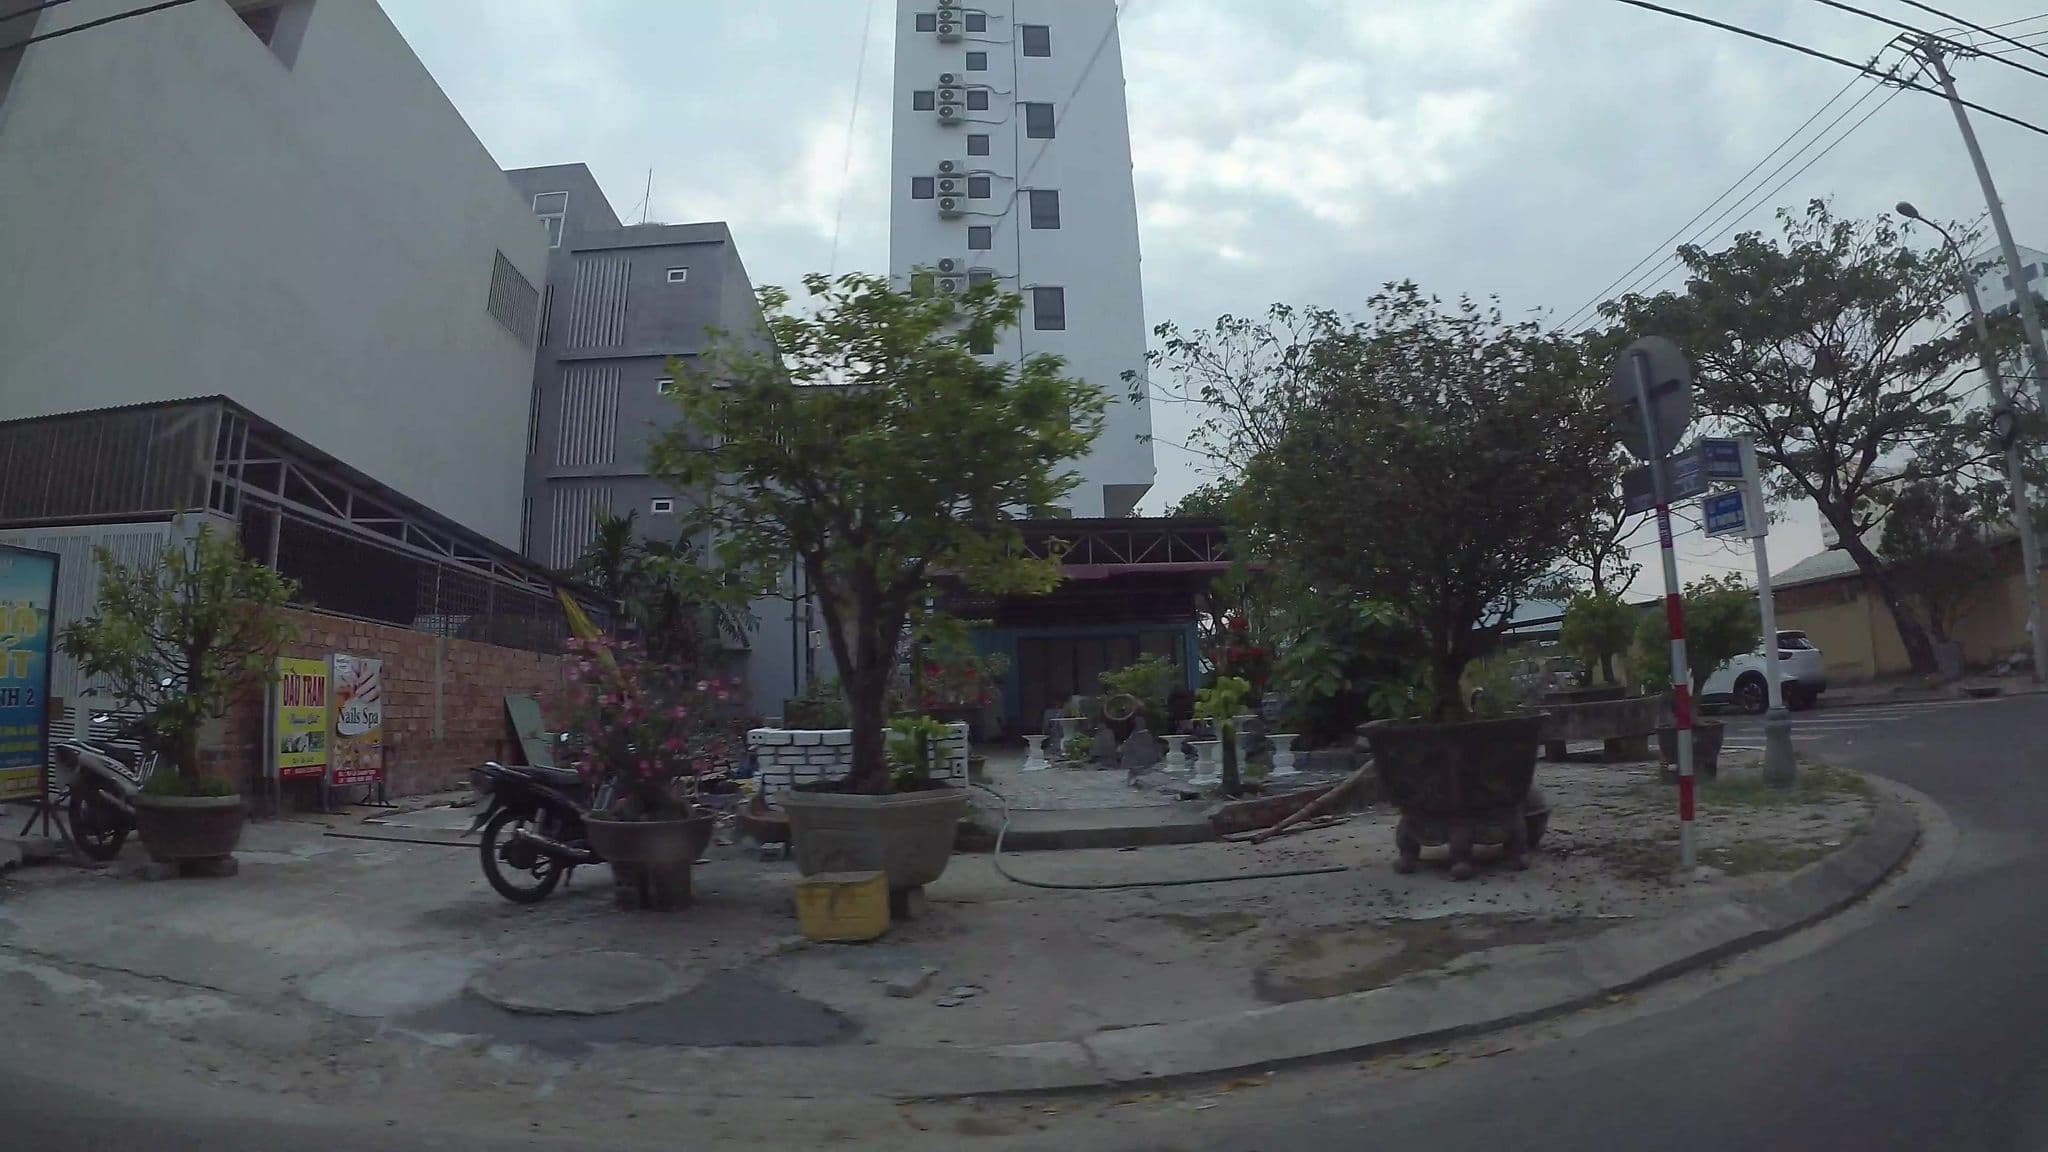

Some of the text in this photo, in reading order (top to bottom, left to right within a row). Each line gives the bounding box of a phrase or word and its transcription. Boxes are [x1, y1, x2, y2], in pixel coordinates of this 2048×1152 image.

[25, 687, 35, 707] 2
[336, 704, 361, 724] Nails
[362, 706, 379, 728] Spa
